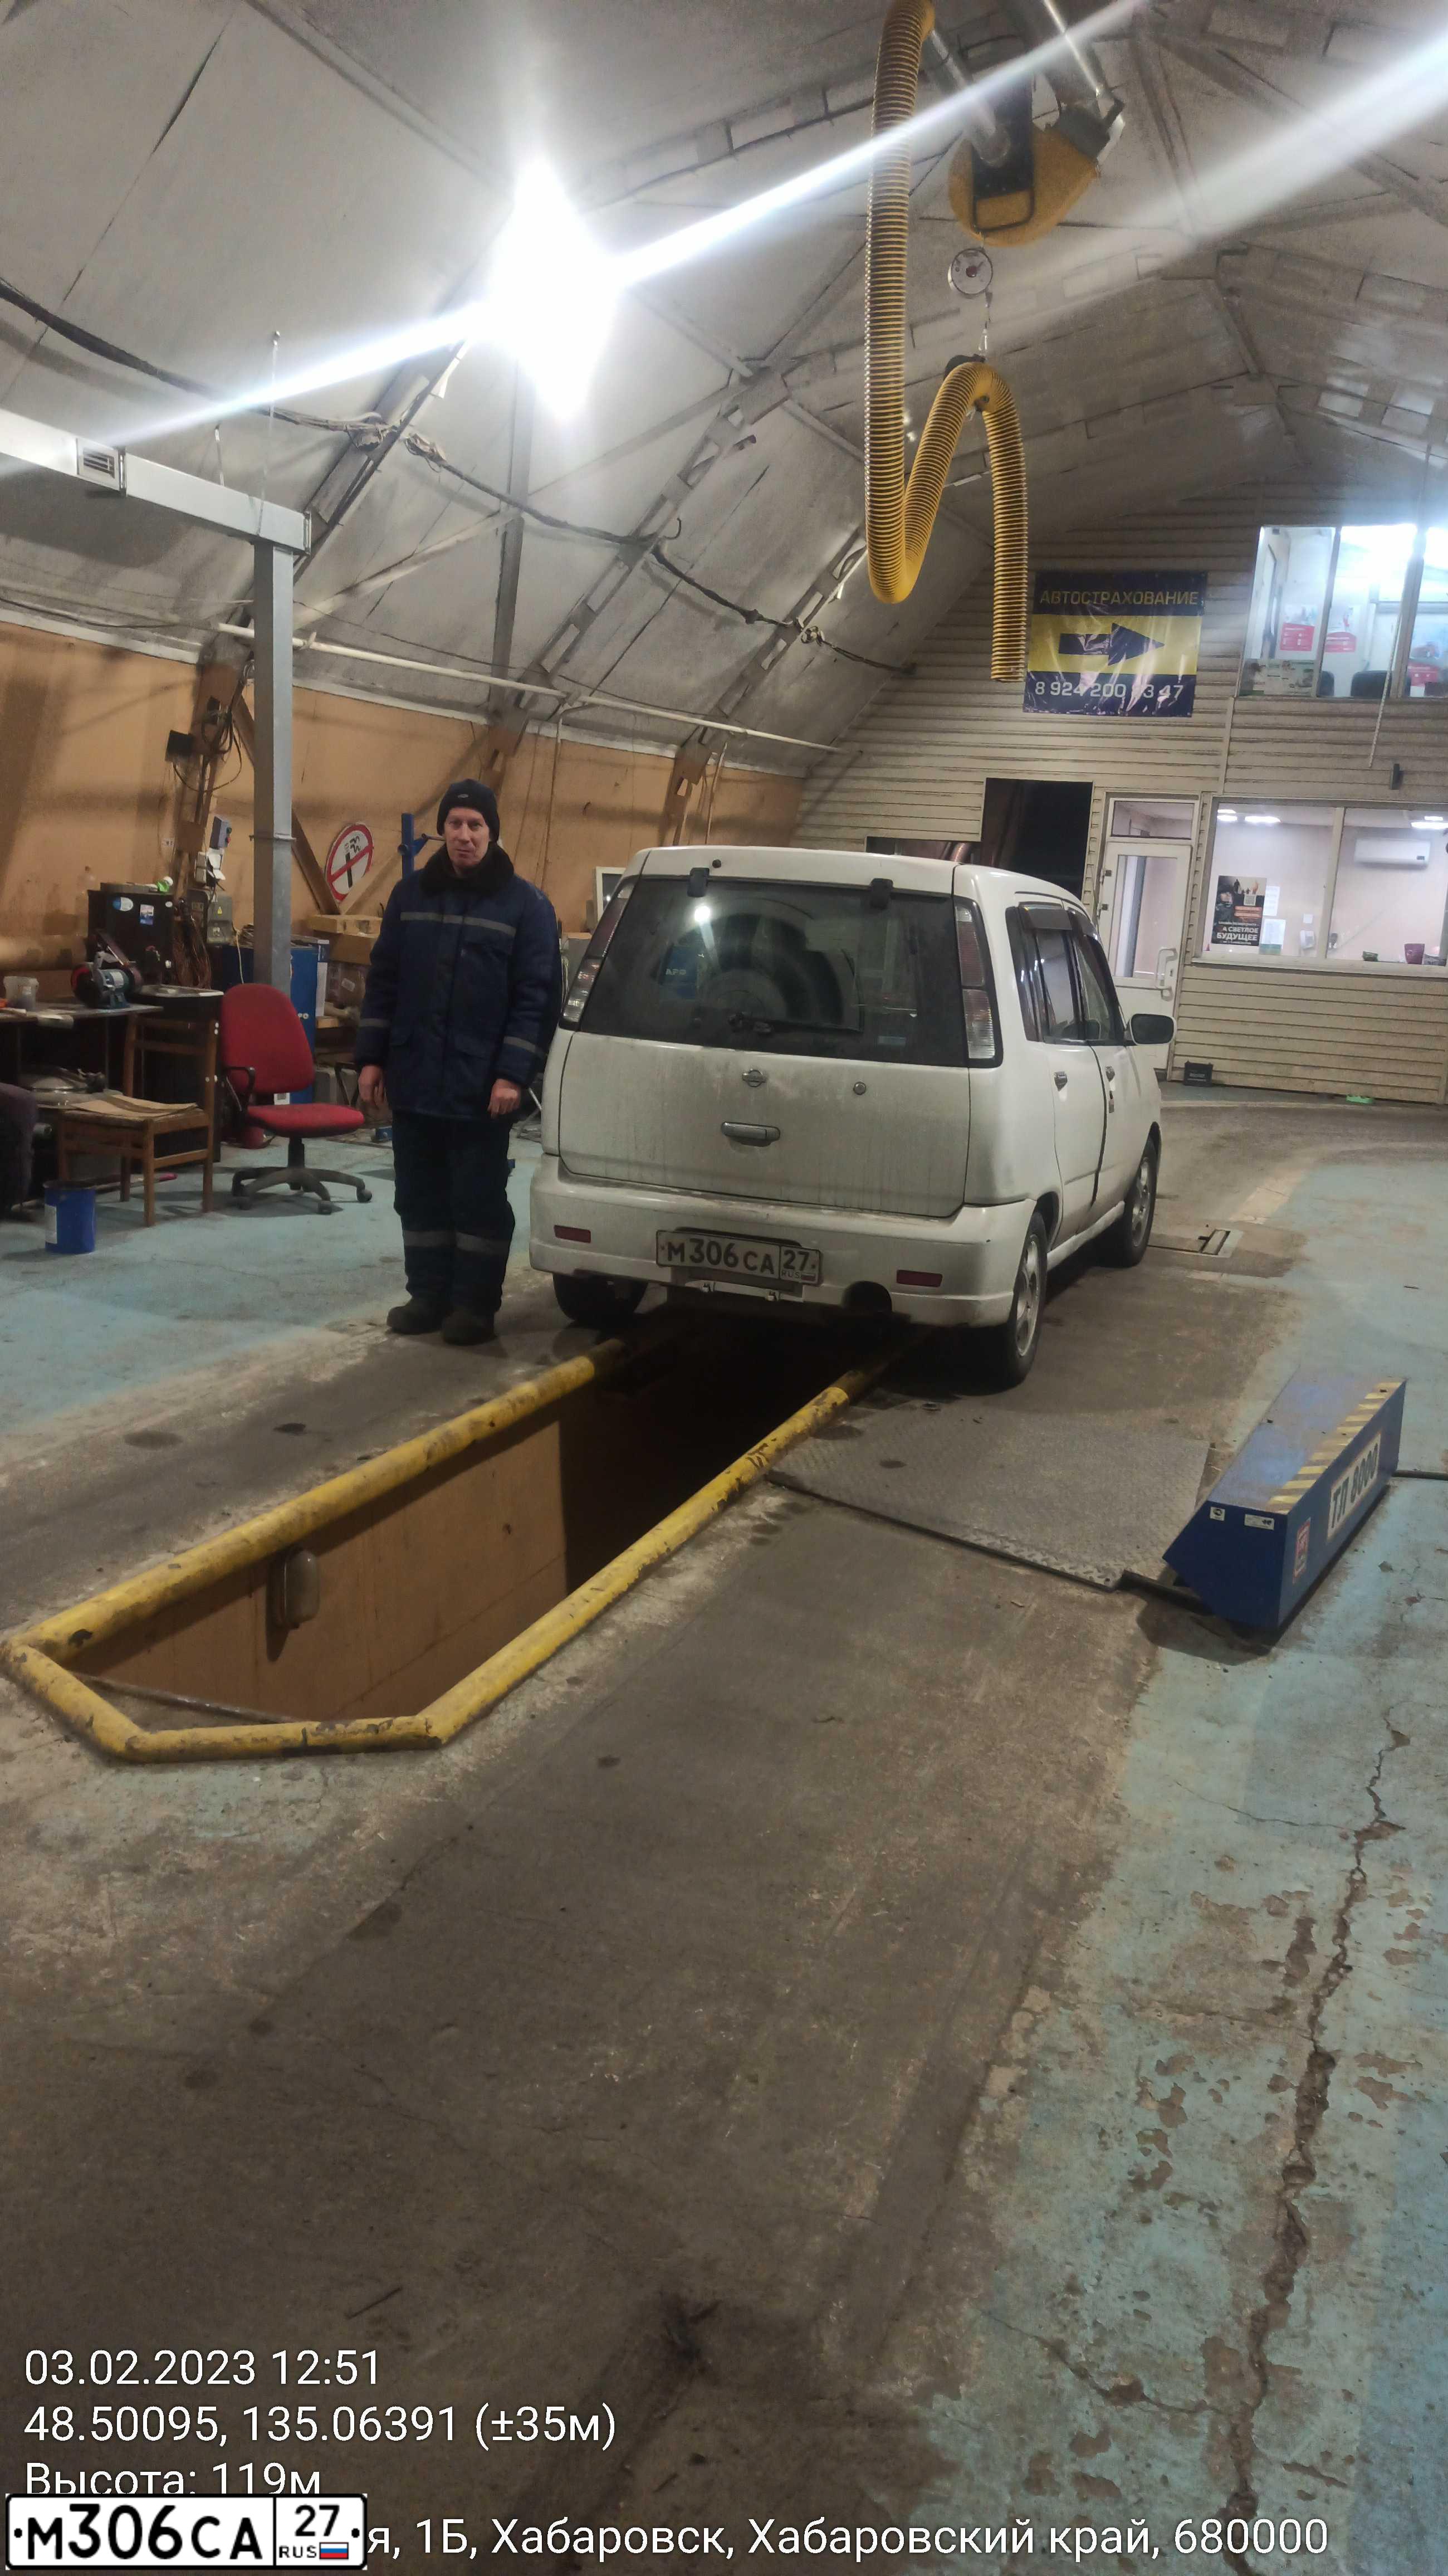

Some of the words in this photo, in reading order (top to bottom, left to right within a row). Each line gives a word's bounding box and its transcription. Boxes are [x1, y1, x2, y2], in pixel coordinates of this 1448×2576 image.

[1040, 590, 1199, 606] АВТОСТРАХОВАНИЕ
[1035, 681, 1045, 695] 8
[1050, 682, 1085, 696] 924
[1090, 684, 1127, 697] 200
[1217, 933, 1258, 941] БУДУЩЕЕ
[668, 1238, 775, 1275] М306СА
[784, 1249, 810, 1271] 27
[781, 1270, 800, 1279] RUS
